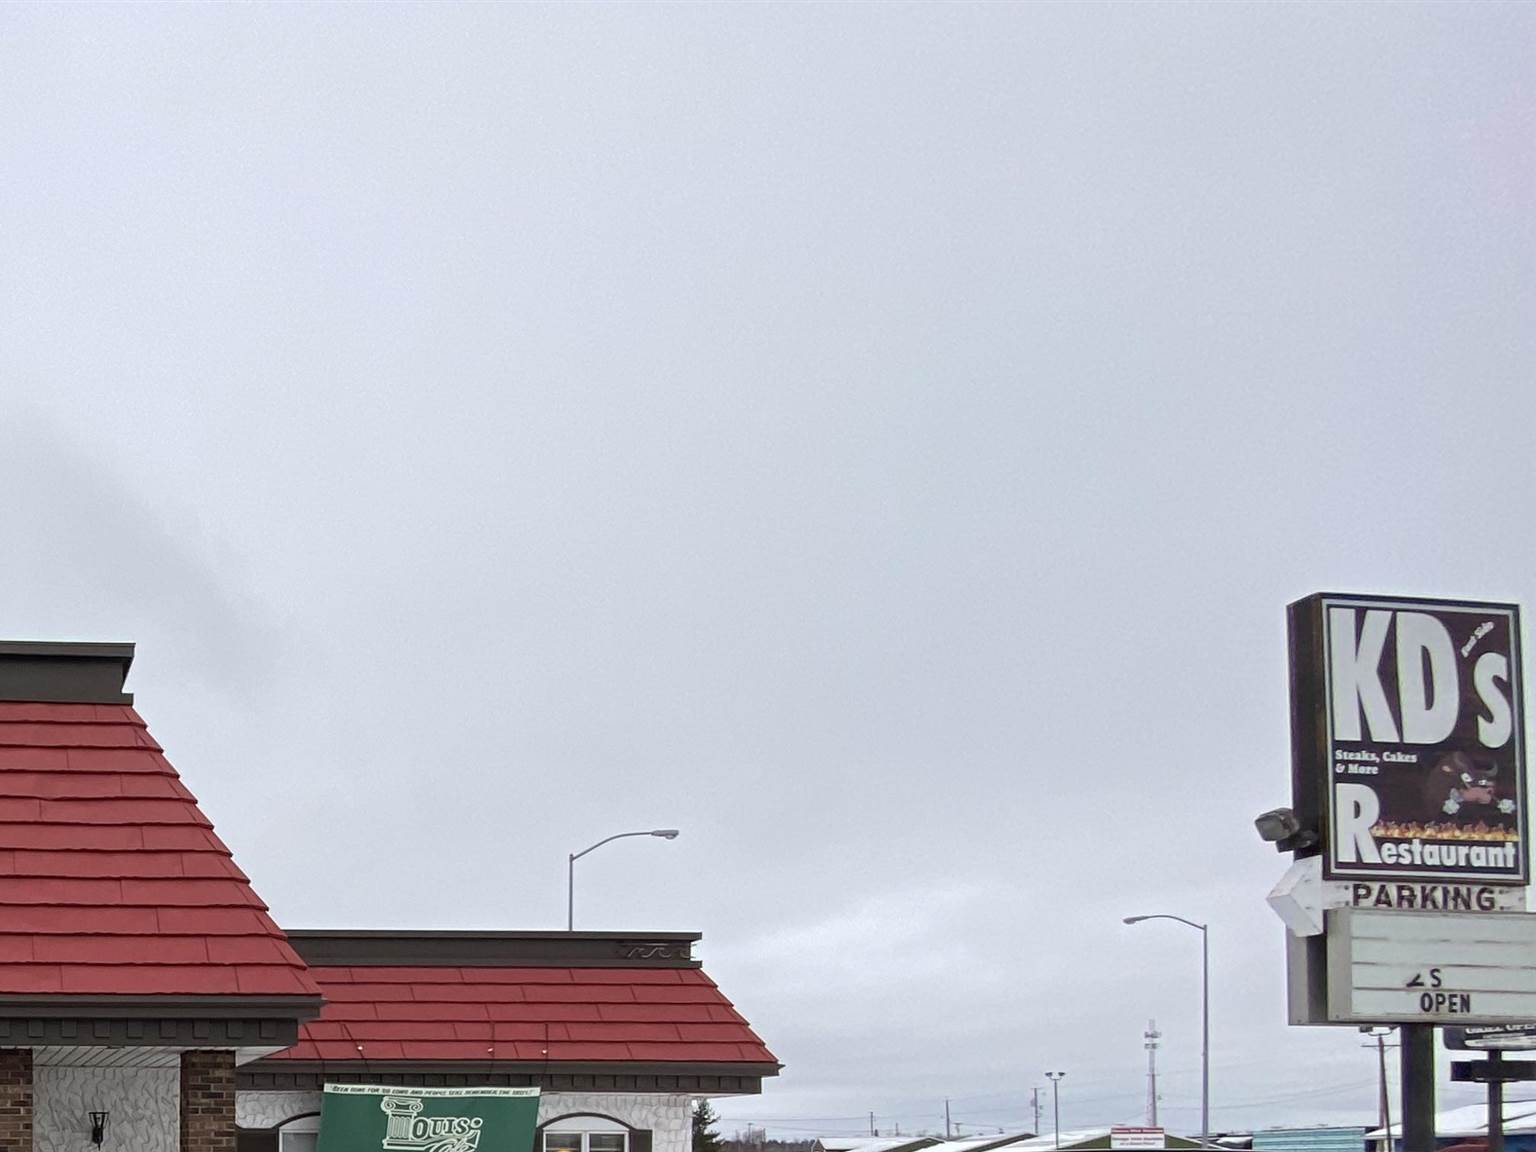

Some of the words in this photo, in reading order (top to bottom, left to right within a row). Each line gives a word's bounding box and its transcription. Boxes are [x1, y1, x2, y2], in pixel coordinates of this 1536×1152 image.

[1335, 749, 1380, 763] Steaks,
[1383, 752, 1417, 763] Cakes
[1335, 763, 1345, 773] &
[1348, 763, 1379, 774] More
[1335, 782, 1516, 868] Restaurant
[1352, 883, 1496, 911] PARKING
[1420, 992, 1470, 1013] OPEN
